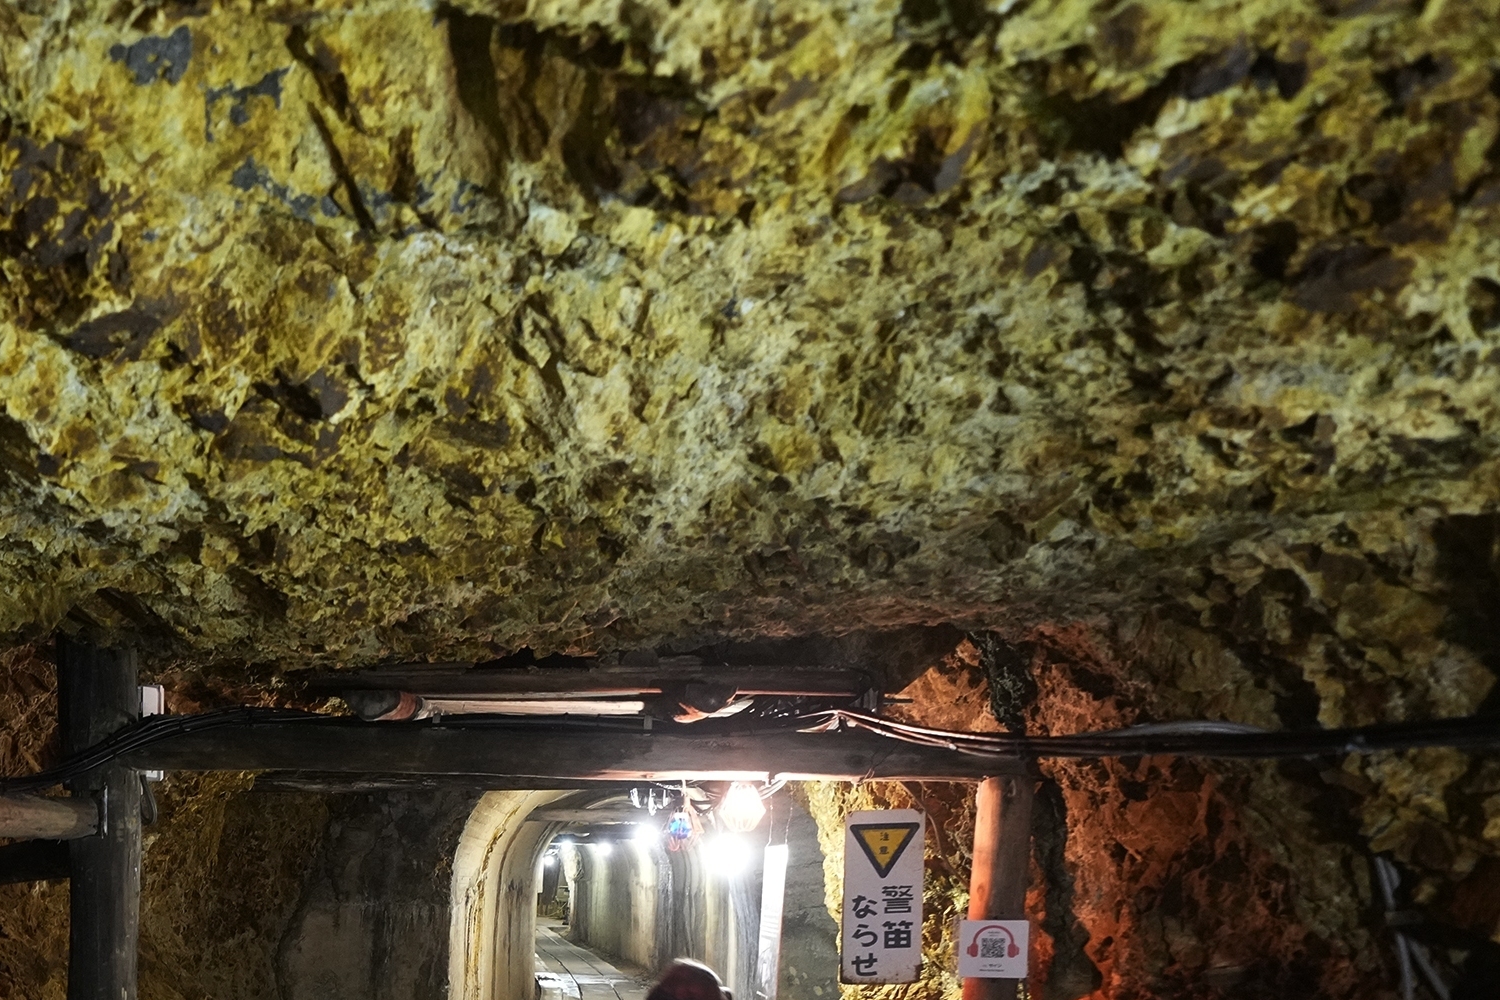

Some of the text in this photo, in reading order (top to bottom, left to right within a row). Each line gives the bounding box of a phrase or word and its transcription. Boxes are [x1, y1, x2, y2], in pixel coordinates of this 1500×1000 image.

[851, 894, 879, 977] ならせ
[881, 884, 914, 949] 警笛
